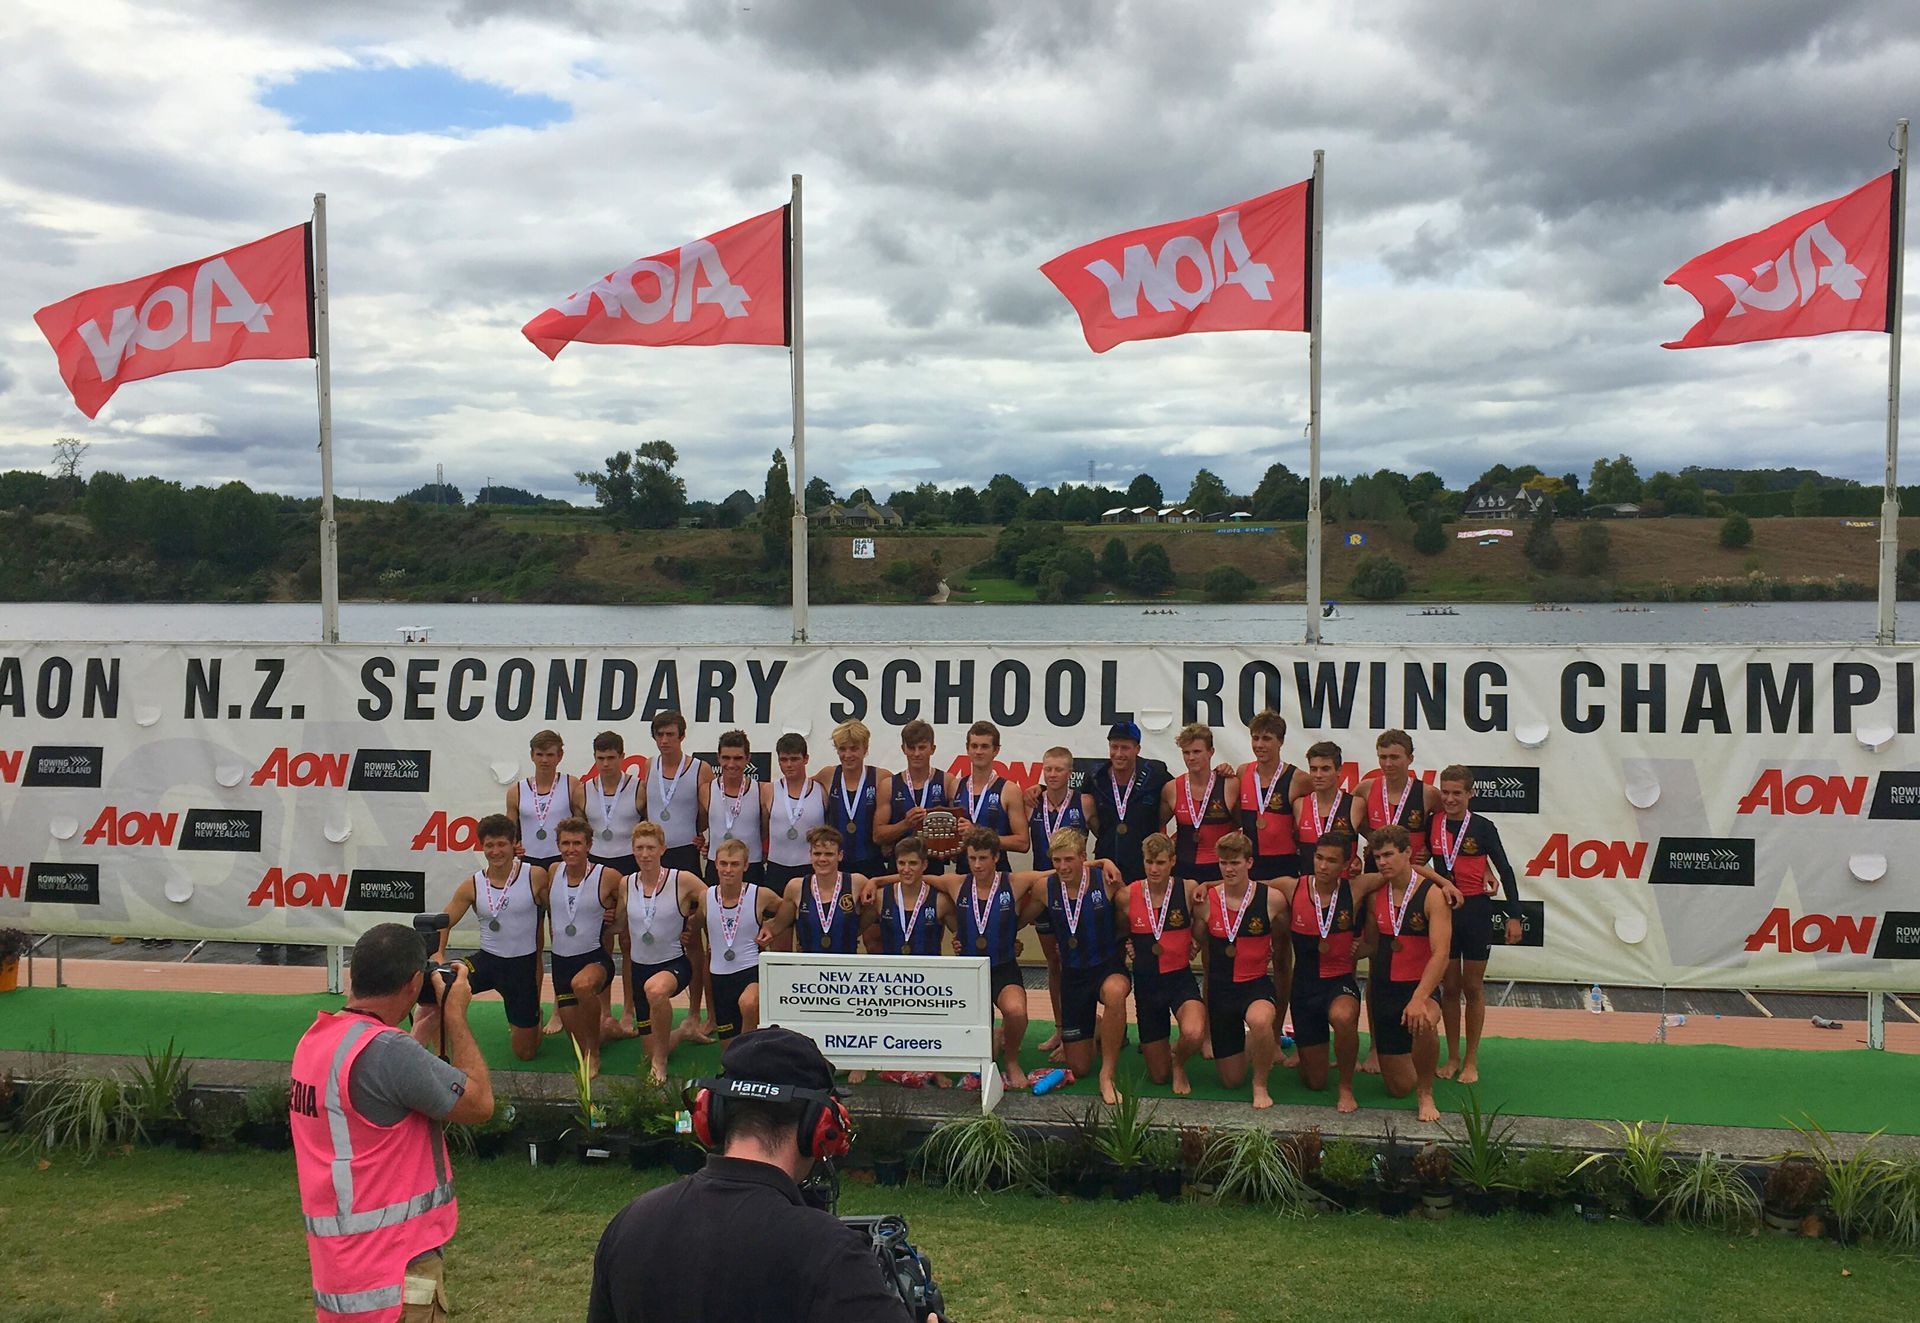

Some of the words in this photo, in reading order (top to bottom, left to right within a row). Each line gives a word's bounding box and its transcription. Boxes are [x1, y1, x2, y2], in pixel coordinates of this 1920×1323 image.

[184, 658, 305, 720] N.Z.
[358, 656, 789, 724] SECONDARY
[830, 658, 1136, 728] SCHOOL
[1183, 660, 1508, 732] ROWING
[1561, 660, 1915, 734] CHAMPI
[38, 758, 69, 767] ROWING
[250, 747, 350, 787] AON
[364, 762, 396, 771] ROWING
[38, 766, 55, 774] NEW
[57, 766, 91, 775] ZEALAND
[364, 770, 382, 778] NEW
[383, 770, 419, 778] ZEALAND
[1482, 789, 1525, 798] ZEALAND
[1736, 769, 1869, 815] AON
[1891, 786, 1920, 796] ROWI
[1891, 795, 1915, 804] NEW
[82, 806, 179, 846] AON
[195, 822, 228, 831] ROWING
[195, 830, 213, 838] NEW
[214, 830, 250, 839] ZEALAND
[410, 811, 484, 852] AO
[1524, 833, 1649, 879] AON
[1670, 852, 1710, 861] ROWING
[1669, 861, 1692, 869] NEW
[1694, 861, 1740, 871] ZEALAND
[38, 875, 67, 884] ROWING
[248, 867, 348, 907] AON
[360, 883, 391, 892] ROWING
[360, 890, 378, 898] NEW
[379, 891, 414, 900] ZEALAND
[1743, 907, 1877, 954] AON
[819, 972, 852, 983] NEW
[858, 972, 925, 984] ZEALAND
[792, 983, 879, 996] SECONDARY
[884, 984, 953, 997] SCHOOLS
[779, 995, 841, 1006] ROWING
[847, 997, 967, 1009] CHAMPIONSHIPS
[856, 1008, 888, 1017] 2019
[825, 1034, 878, 1049] RNZAF
[883, 1035, 942, 1050] Careers
[730, 1080, 780, 1096] Harris
